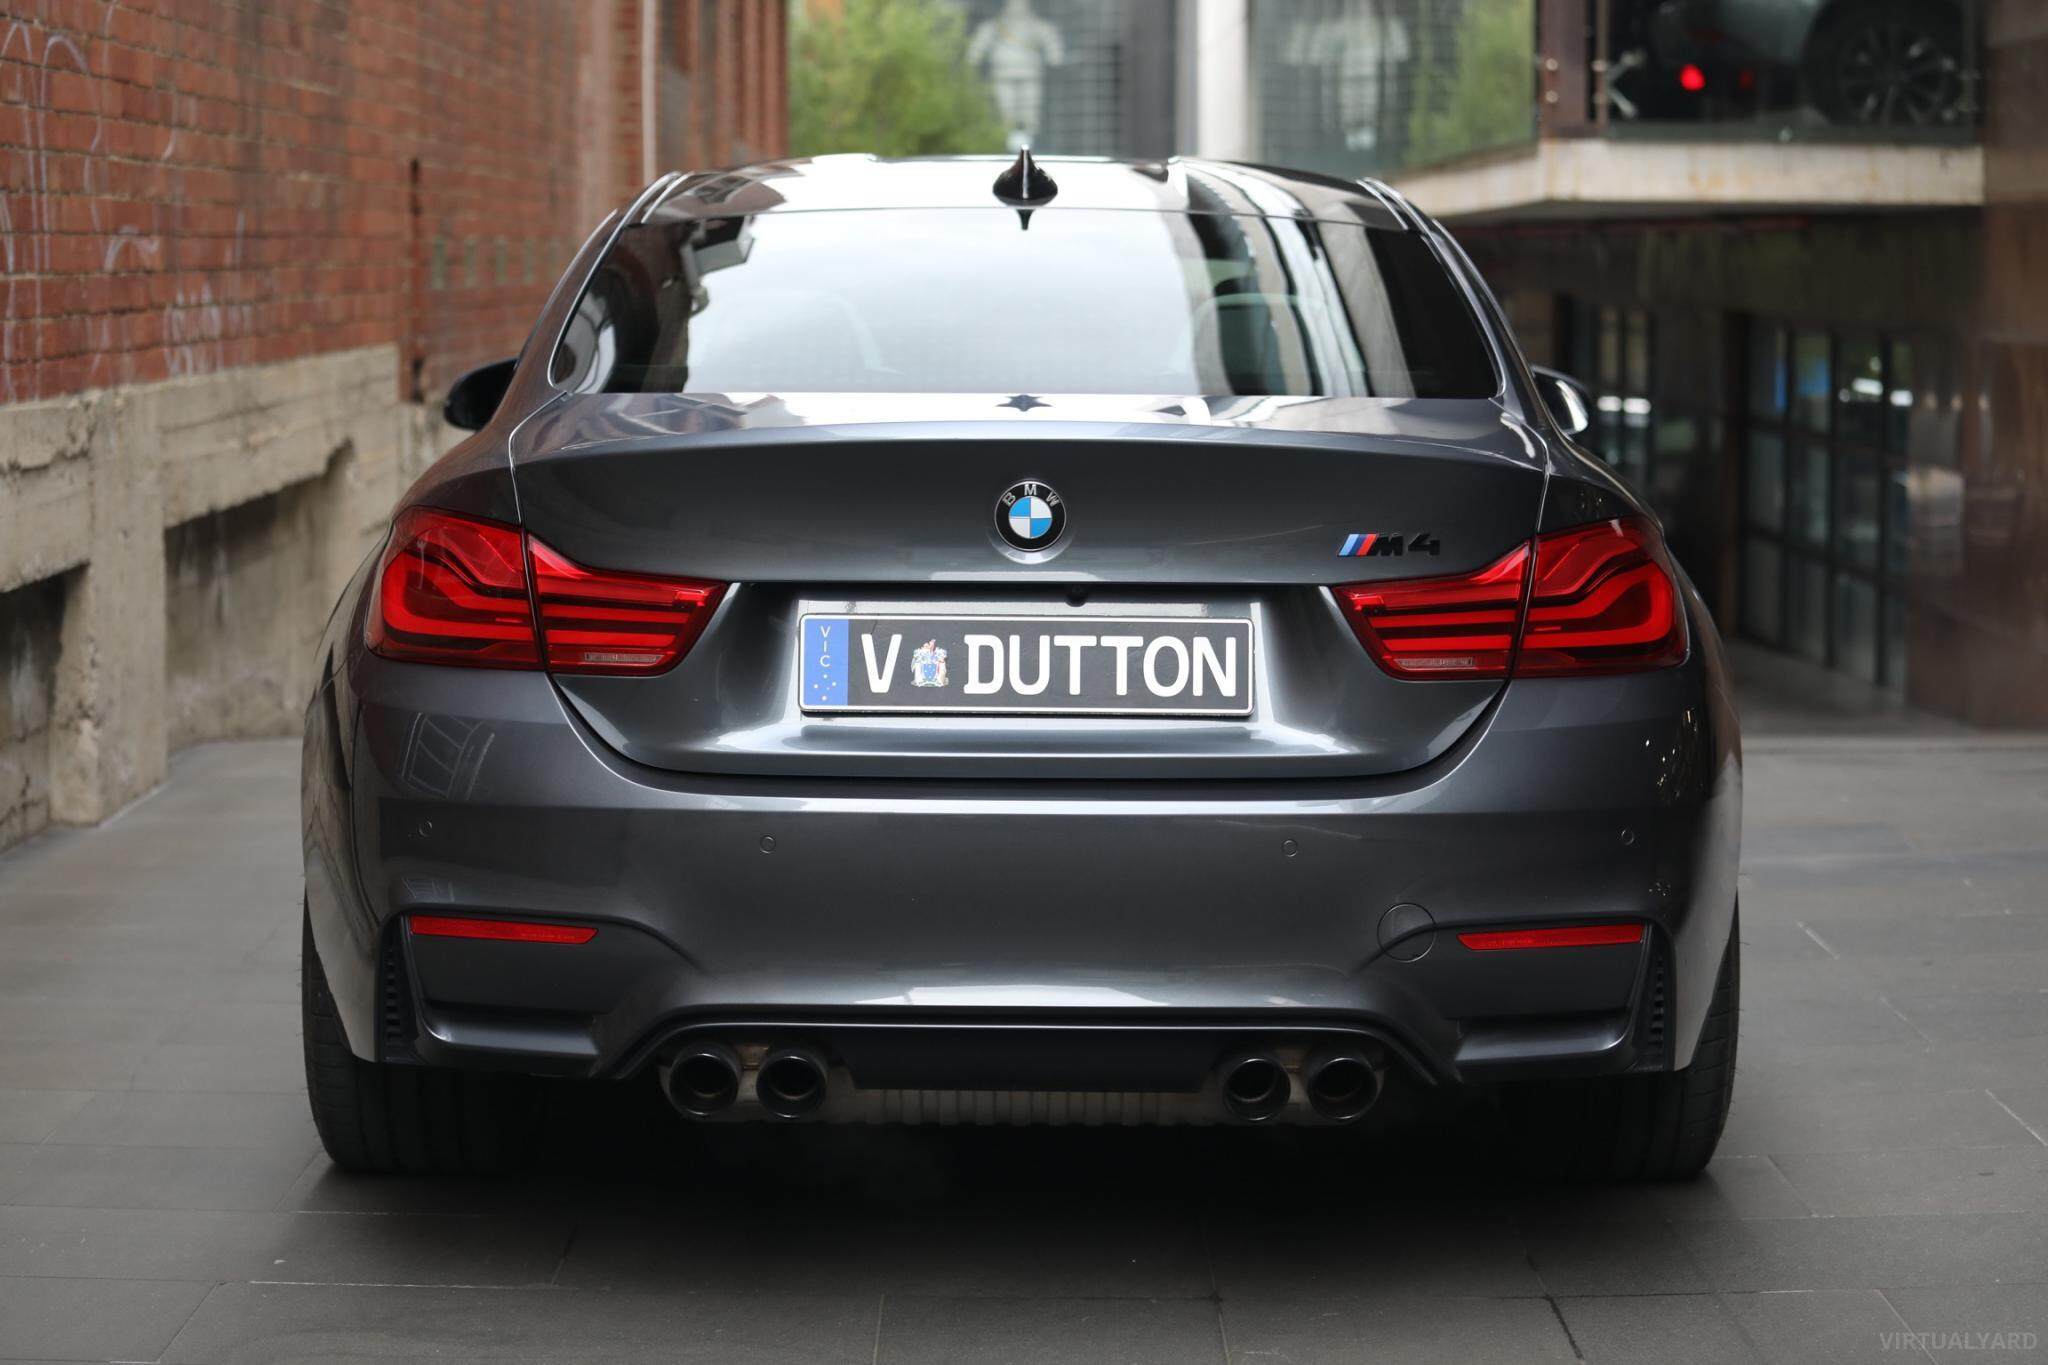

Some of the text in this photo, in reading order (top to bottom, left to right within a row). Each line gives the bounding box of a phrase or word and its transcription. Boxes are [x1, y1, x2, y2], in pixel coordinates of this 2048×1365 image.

[1002, 483, 1060, 507] BMW
[1364, 532, 1441, 556] M4
[820, 625, 832, 668] VIC
[861, 633, 1237, 697] V DUTTON
